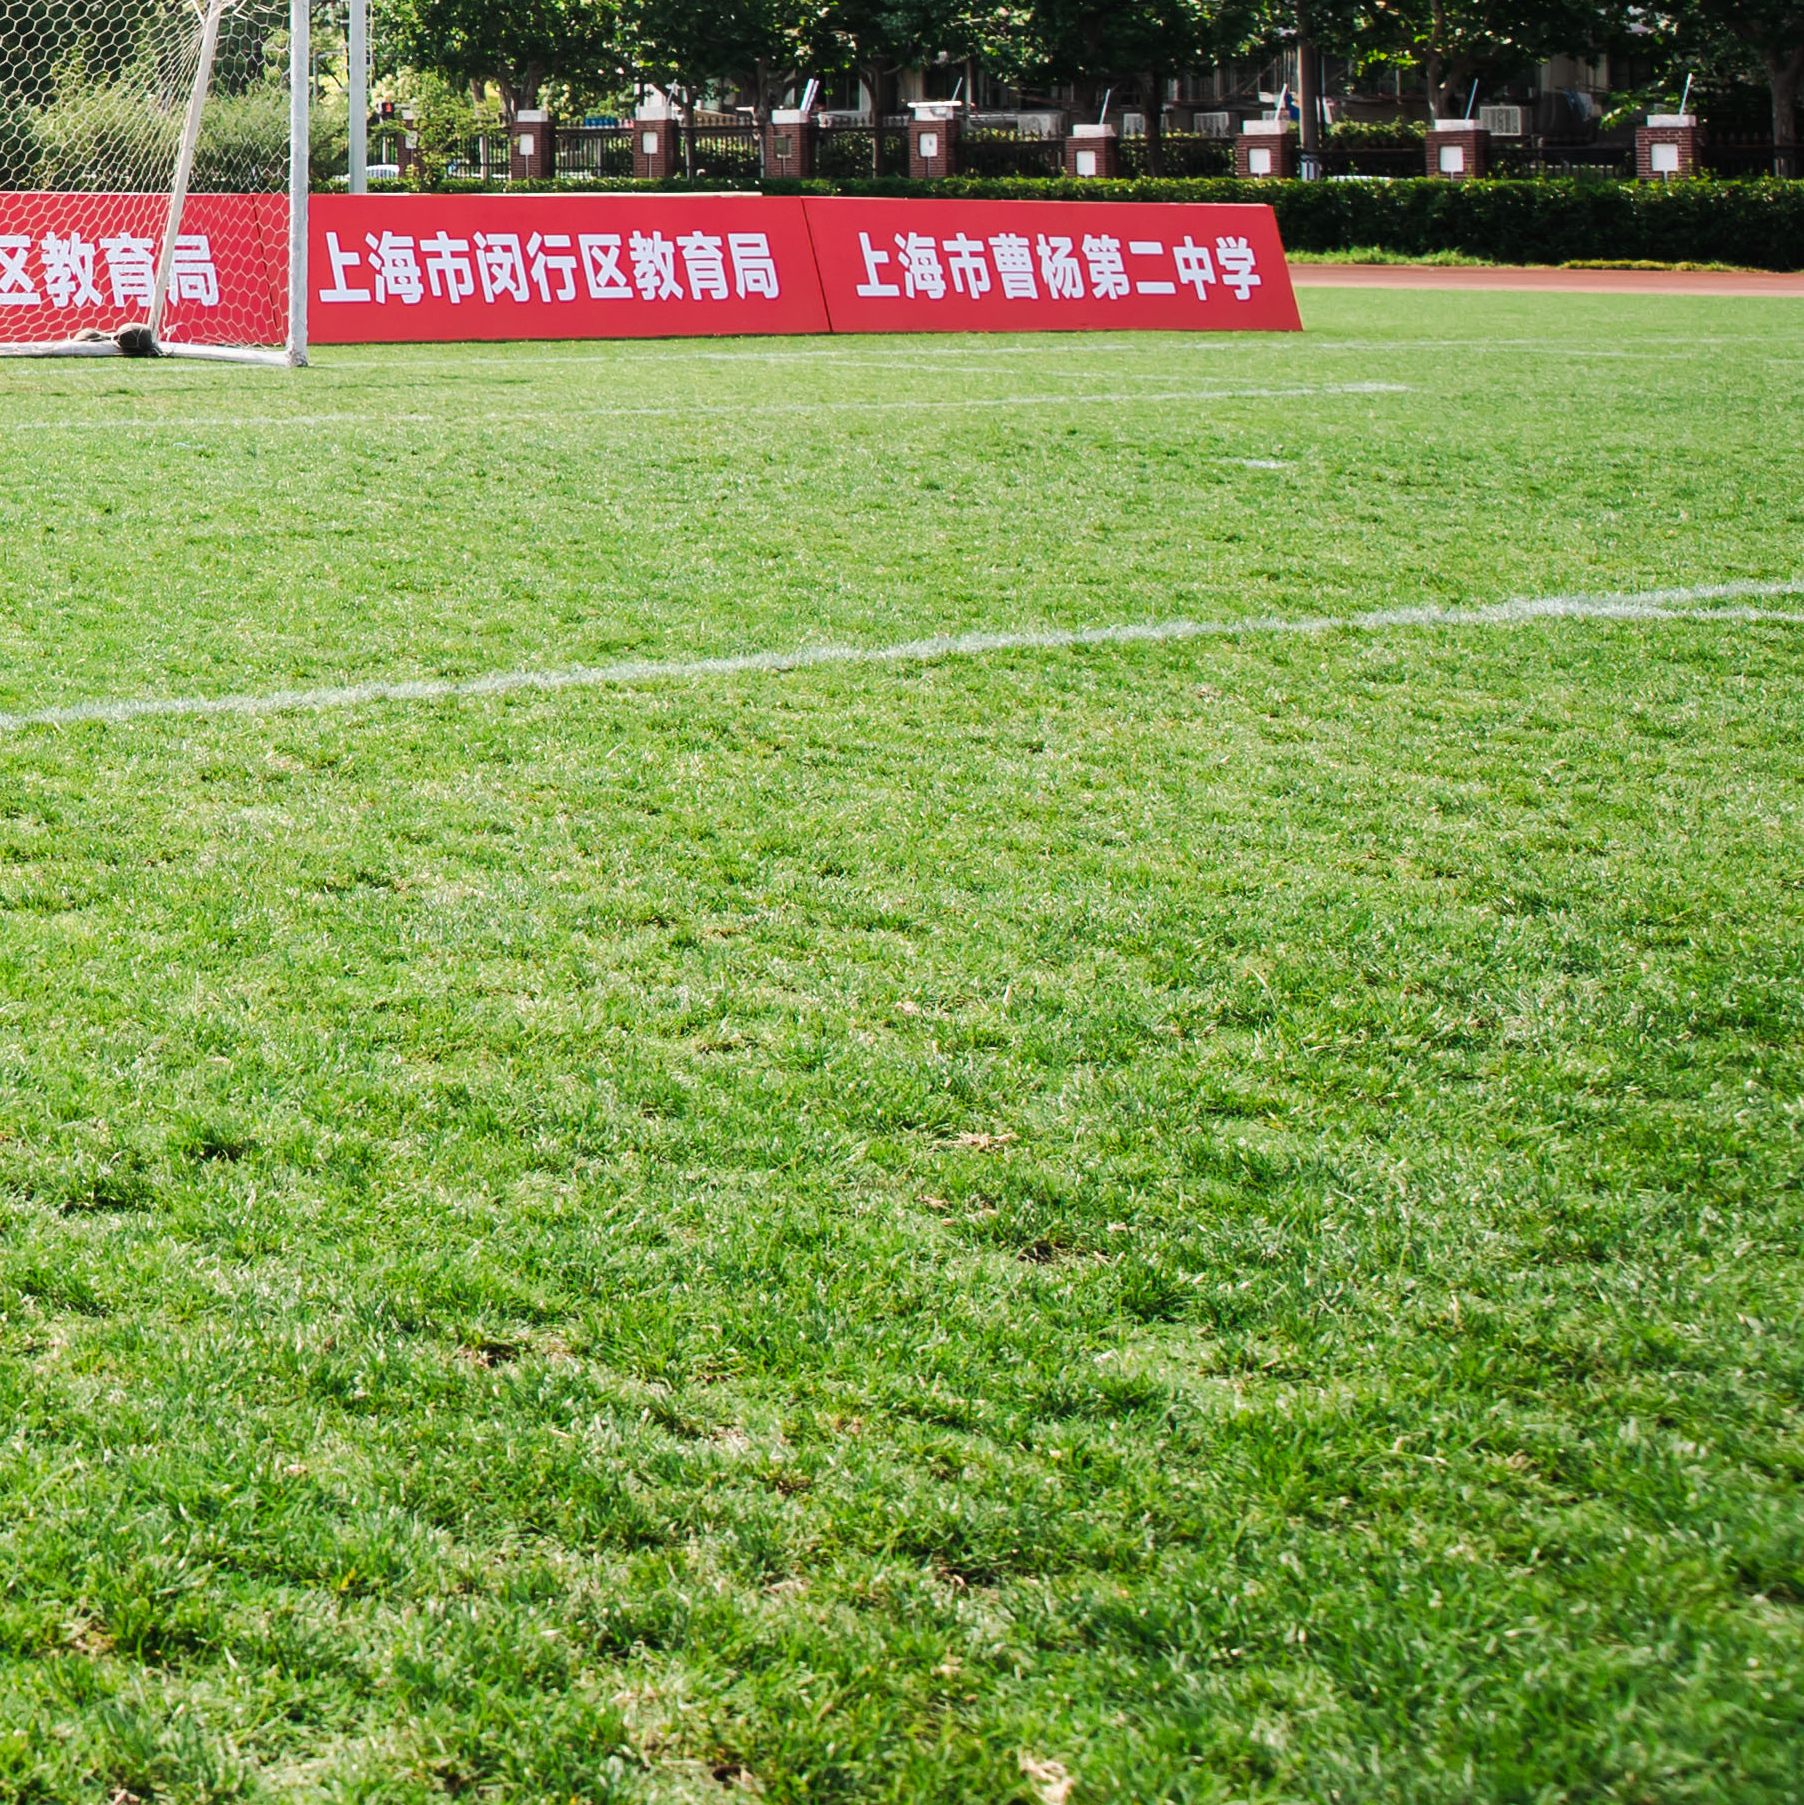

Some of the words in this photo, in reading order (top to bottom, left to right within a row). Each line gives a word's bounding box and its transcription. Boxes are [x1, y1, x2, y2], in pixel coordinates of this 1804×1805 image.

[318, 230, 780, 304] 上海市闵行区教育局
[856, 231, 1262, 301] 上海市曹杨第二中学
